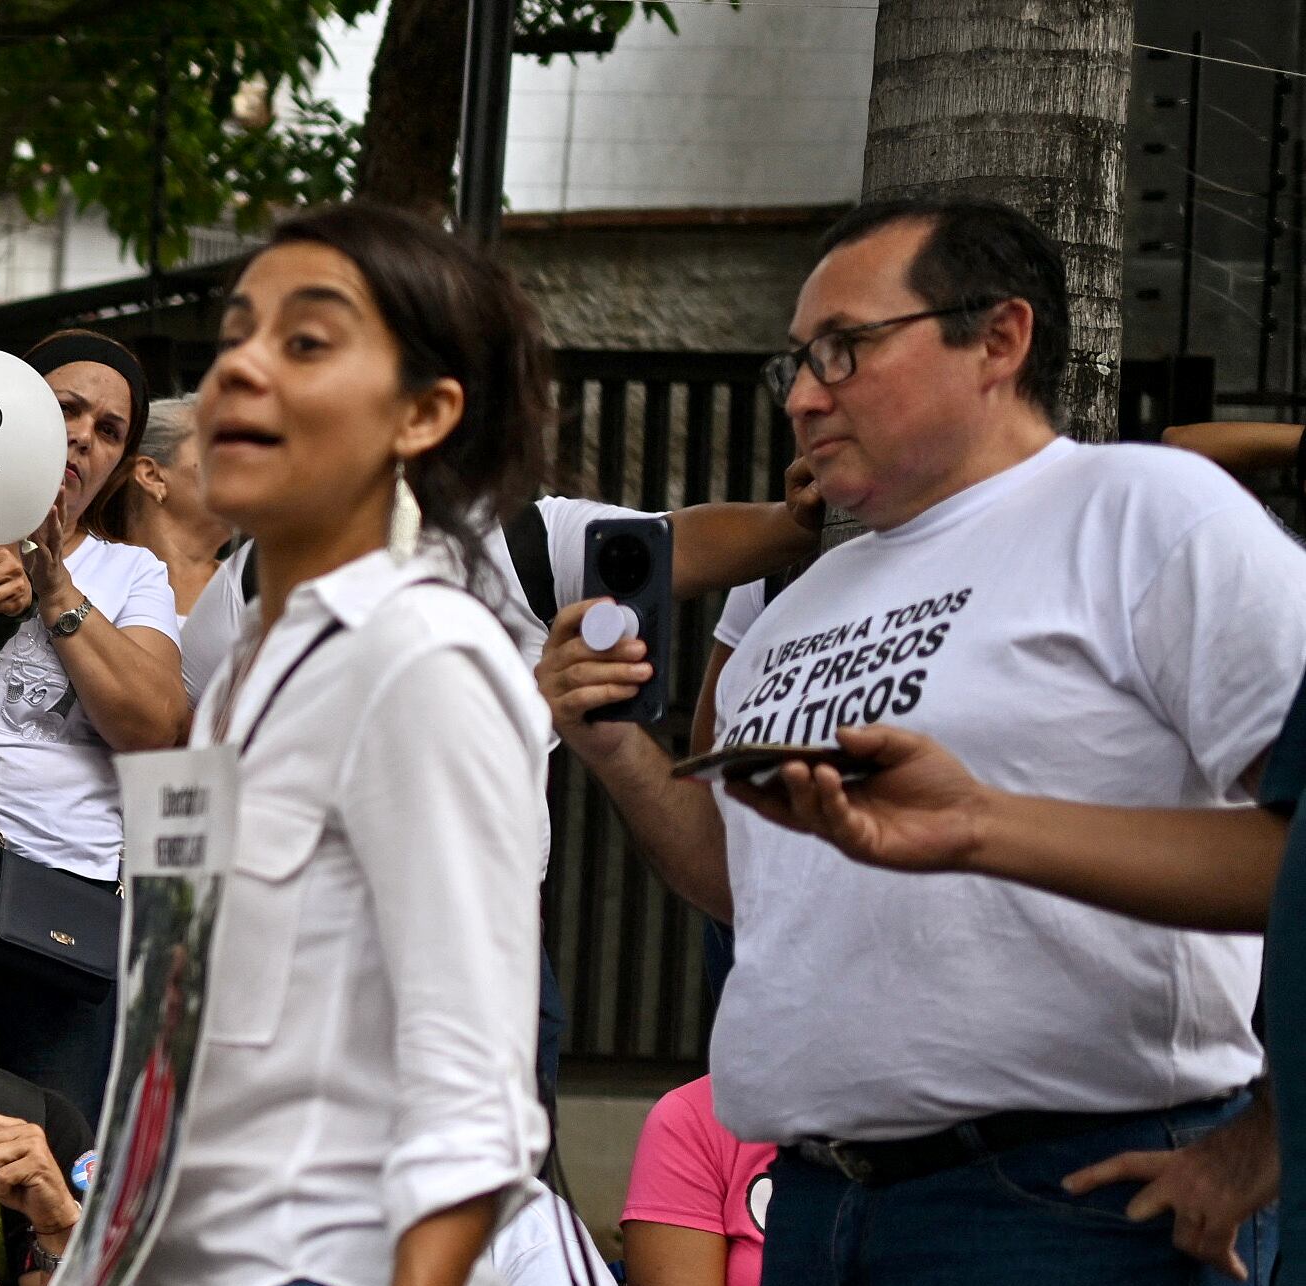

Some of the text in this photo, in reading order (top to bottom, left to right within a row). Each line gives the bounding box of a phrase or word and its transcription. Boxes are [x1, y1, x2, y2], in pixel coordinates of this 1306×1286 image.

[737, 621, 952, 715] LOS PRESOS
[762, 587, 974, 676] LIBEREN A TODOS
